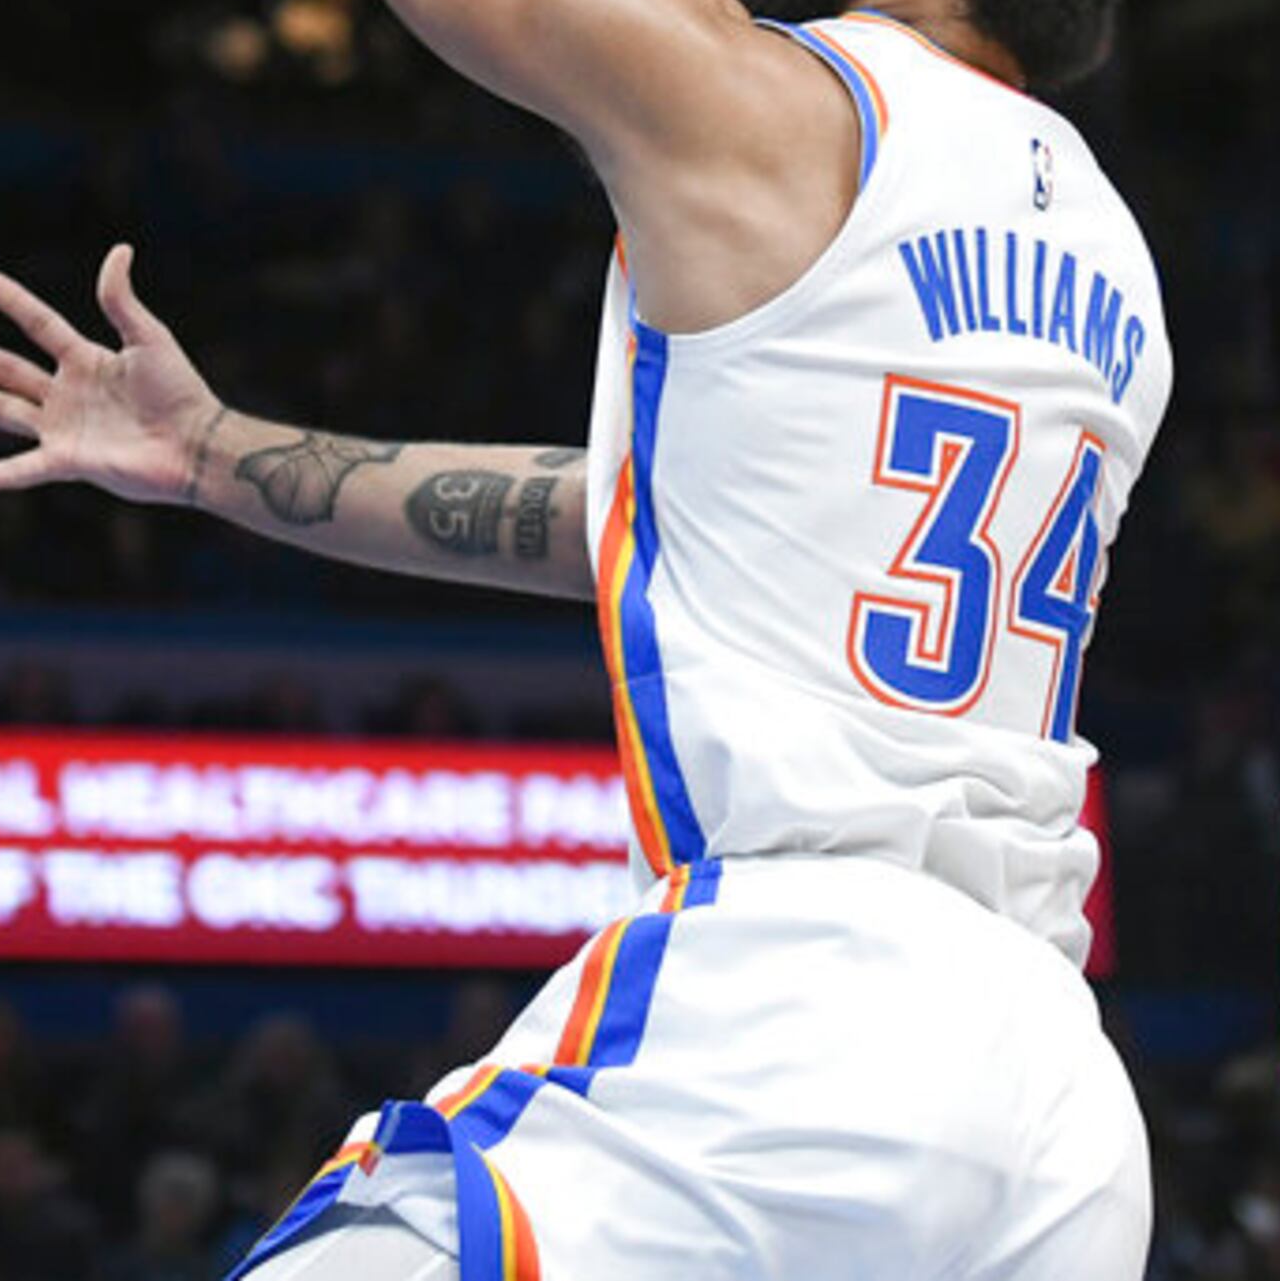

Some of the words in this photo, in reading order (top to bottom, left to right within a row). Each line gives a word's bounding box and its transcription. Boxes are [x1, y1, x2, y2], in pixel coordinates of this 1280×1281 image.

[897, 226, 1145, 405] WILLIAMS
[430, 475, 481, 541] 35
[846, 372, 1110, 746] 34
[59, 762, 513, 845] HEALTHCARE
[520, 772, 628, 848] PA
[42, 850, 185, 927] THE
[188, 853, 345, 931] OKC
